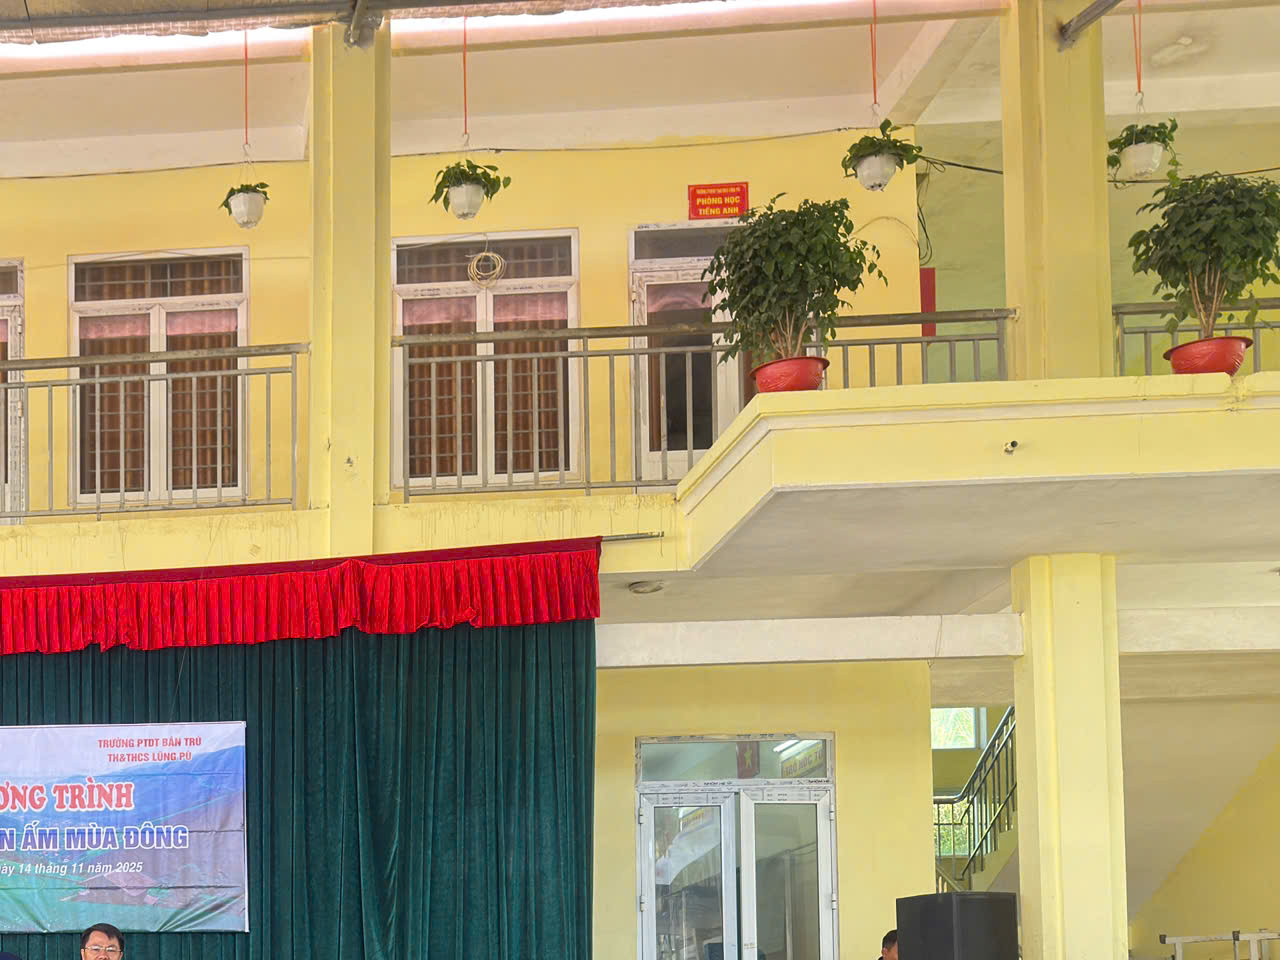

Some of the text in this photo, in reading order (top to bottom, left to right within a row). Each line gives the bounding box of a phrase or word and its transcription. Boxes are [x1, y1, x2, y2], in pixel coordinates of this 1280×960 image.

[98, 737, 134, 748] TRƯỜNG
[137, 738, 159, 747] PTDT
[108, 753, 149, 762] TH&THCS
[53, 776, 134, 810] TRÌNH
[21, 821, 59, 850] ẤM
[65, 823, 119, 850] MÙA
[123, 821, 189, 849] ĐÔNG
[19, 864, 32, 873] 14
[35, 863, 67, 876] tháng
[72, 863, 83, 872] 11
[88, 863, 112, 873] năm
[116, 862, 143, 872] 2025
